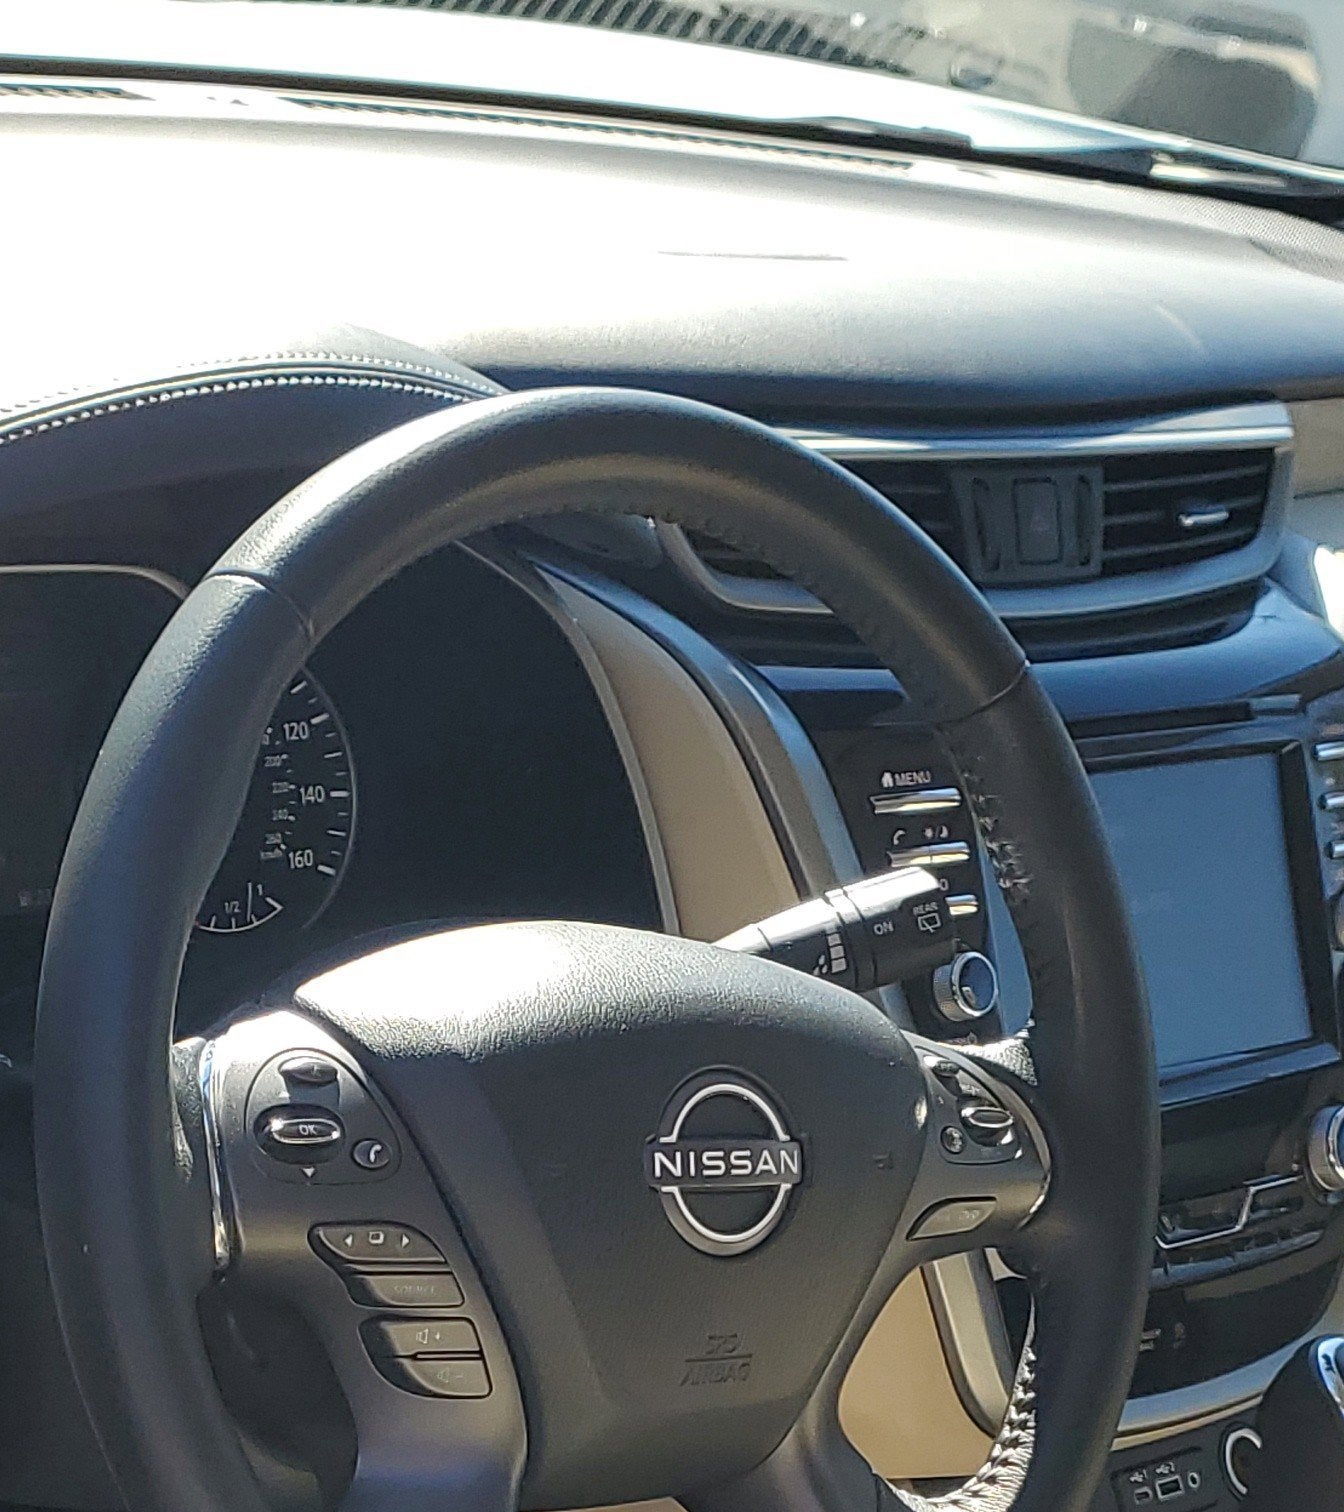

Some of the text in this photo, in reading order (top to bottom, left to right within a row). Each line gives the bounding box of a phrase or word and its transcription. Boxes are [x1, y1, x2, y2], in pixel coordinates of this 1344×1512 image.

[283, 722, 308, 740] 120
[894, 771, 931, 786] MENU
[300, 785, 325, 804] 140
[288, 849, 314, 869] 160
[224, 900, 242, 913] 1/2
[873, 920, 894, 935] ON
[299, 1124, 317, 1136] OK
[654, 1149, 798, 1178] NISSAN
